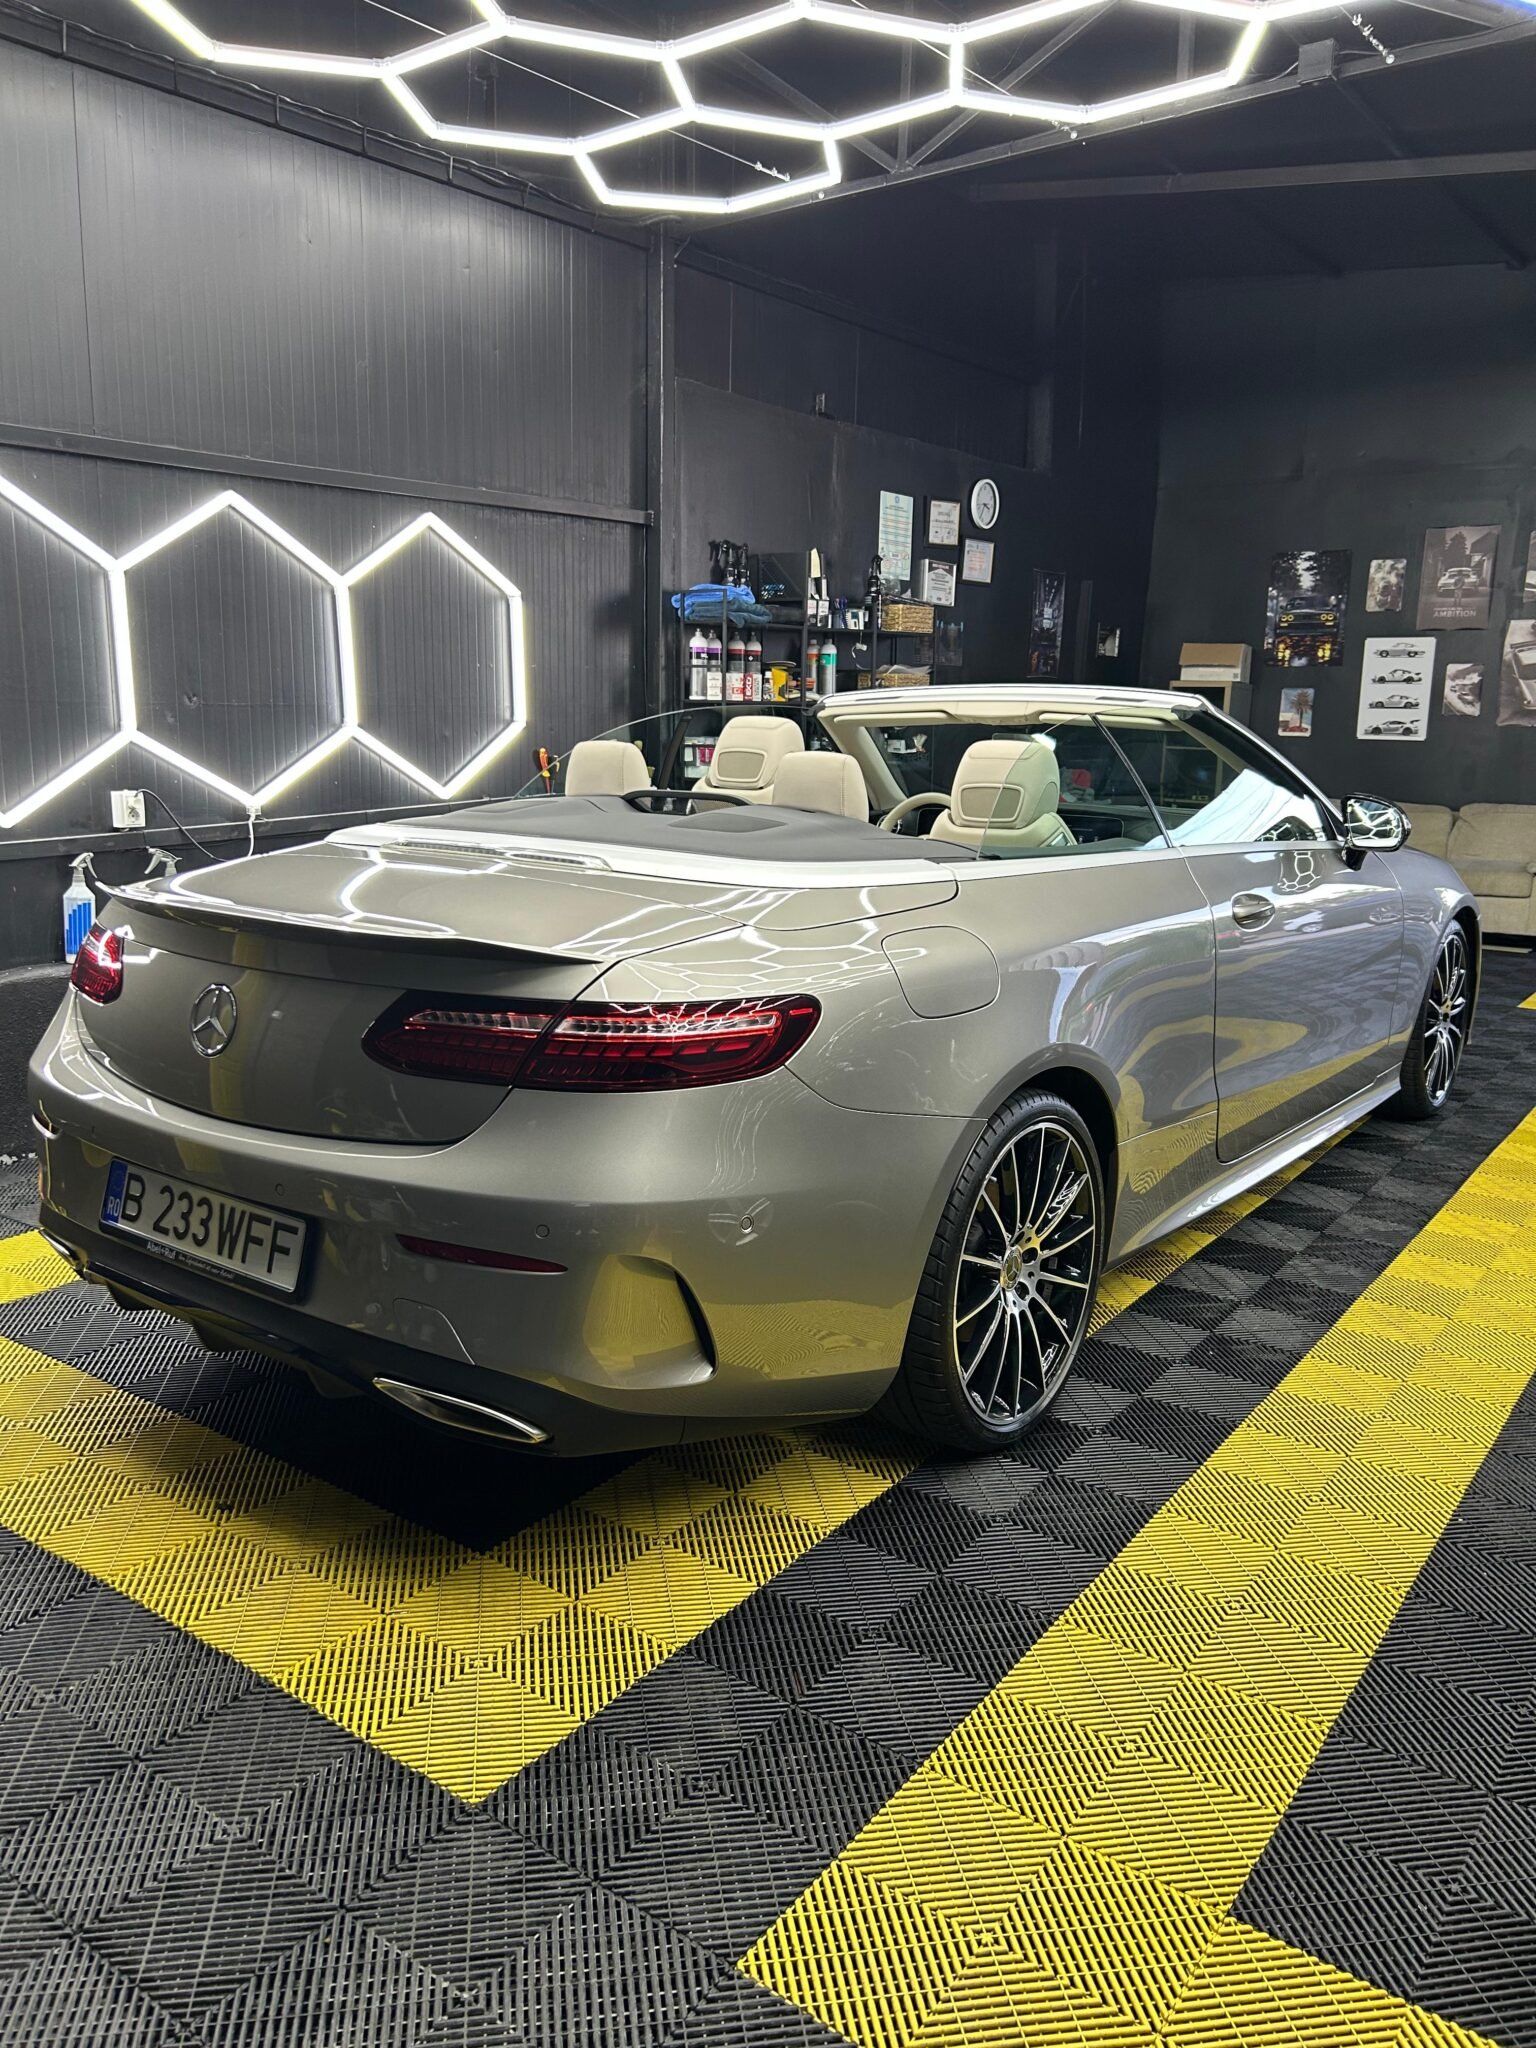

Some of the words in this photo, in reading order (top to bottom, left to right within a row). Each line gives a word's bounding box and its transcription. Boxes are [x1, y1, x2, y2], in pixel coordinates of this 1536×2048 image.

[1433, 610, 1477, 618] AMBITION
[107, 1196, 121, 1216] RO
[121, 1172, 146, 1223] B
